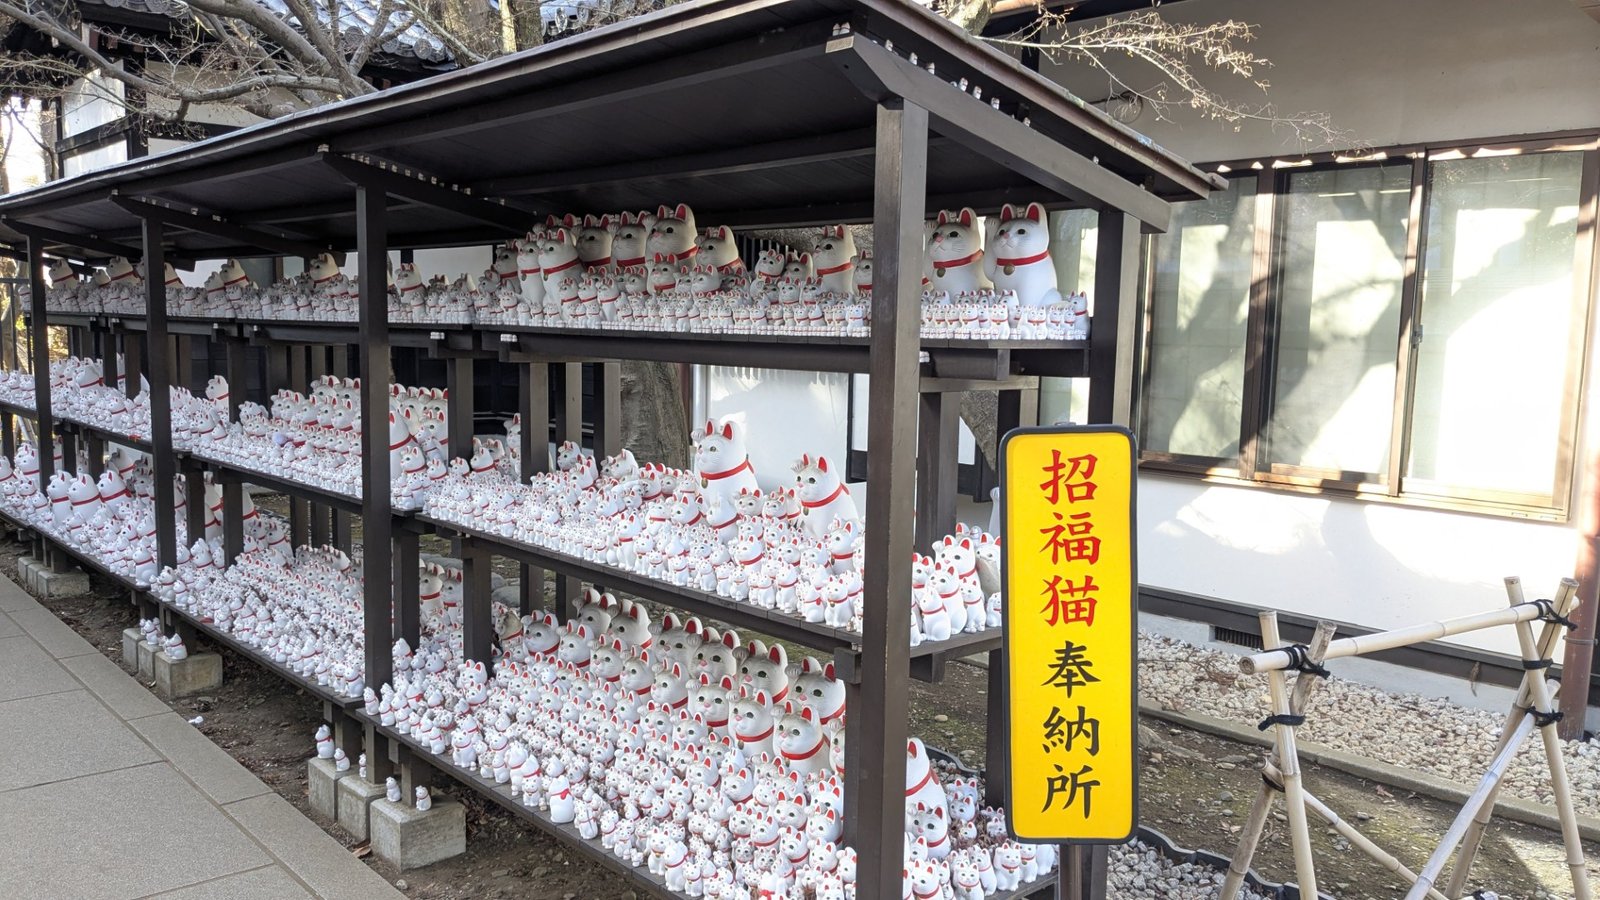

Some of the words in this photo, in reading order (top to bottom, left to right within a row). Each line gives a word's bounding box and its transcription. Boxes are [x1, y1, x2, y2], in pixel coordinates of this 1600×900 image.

[1040, 449, 1101, 819] 招福猫奉納所
